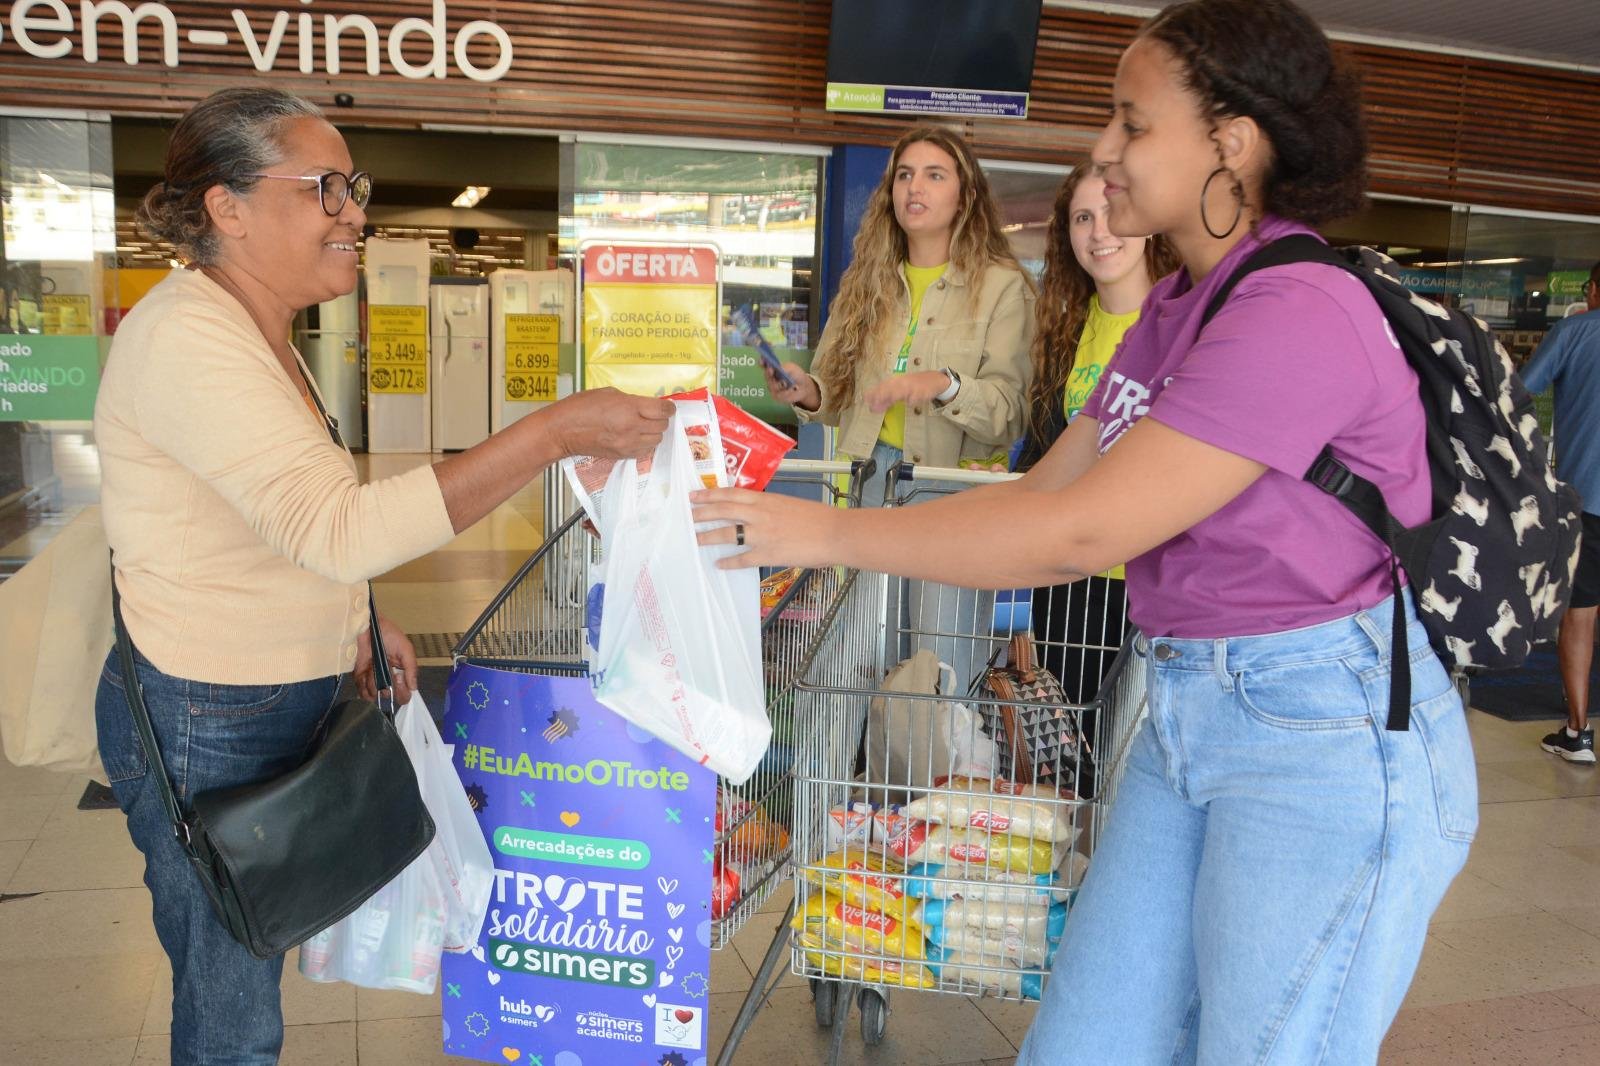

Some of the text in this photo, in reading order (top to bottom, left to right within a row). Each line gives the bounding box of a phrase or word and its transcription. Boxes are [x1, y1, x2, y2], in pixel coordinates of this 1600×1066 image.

[0, 0, 513, 82] em-vindo
[843, 92, 882, 103] Atenção
[597, 252, 699, 277] OFERTA
[610, 311, 691, 325] CORAÇÃO DE
[592, 326, 709, 339] FRANGO PERDIGÃO
[385, 343, 416, 361] 3.449
[515, 353, 550, 369] 6.899
[722, 354, 756, 366] bado
[463, 743, 690, 792] #EuAmoOTrote
[501, 833, 642, 862] Arrecadações do
[488, 907, 655, 955] solidário
[500, 996, 532, 1016] hub
[576, 1025, 643, 1043] acadêmico
